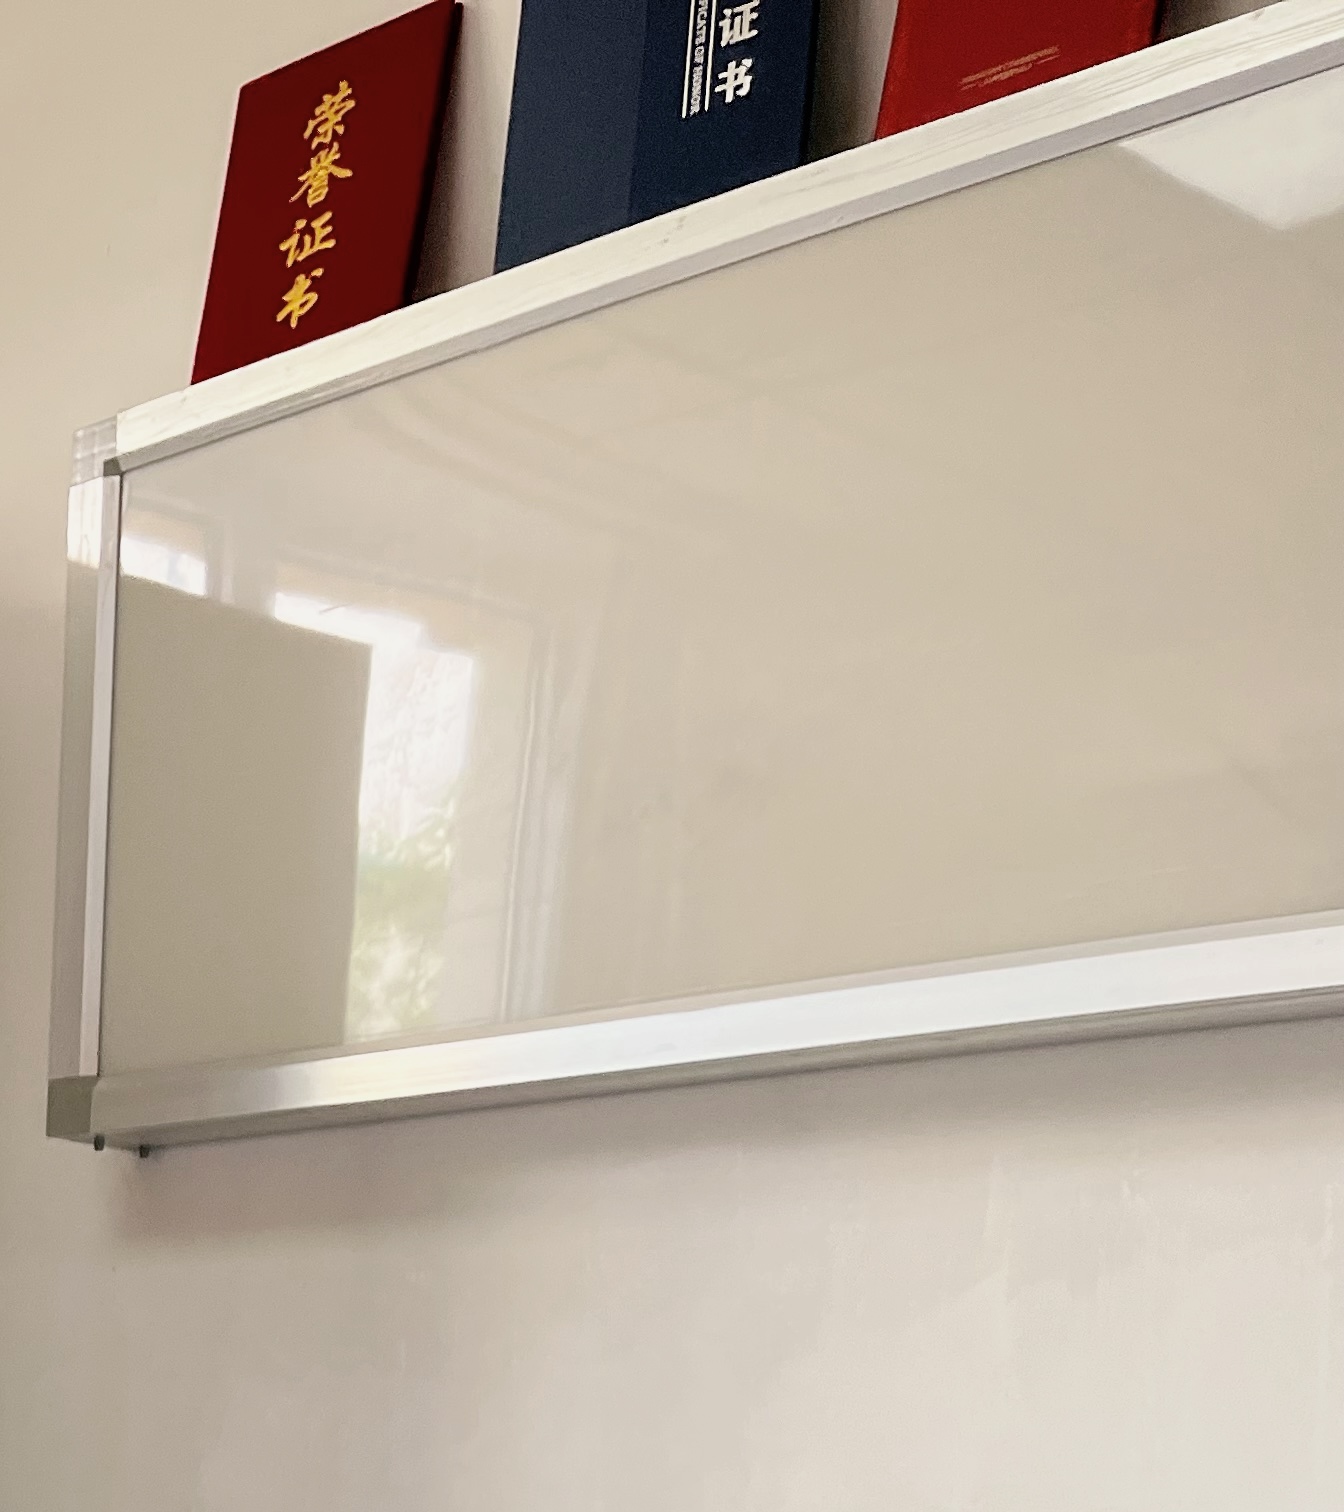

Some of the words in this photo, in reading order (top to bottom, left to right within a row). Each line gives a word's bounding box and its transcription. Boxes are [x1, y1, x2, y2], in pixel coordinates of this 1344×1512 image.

[714, 0, 760, 104] 证书
[274, 79, 357, 330] 荣誉证书
